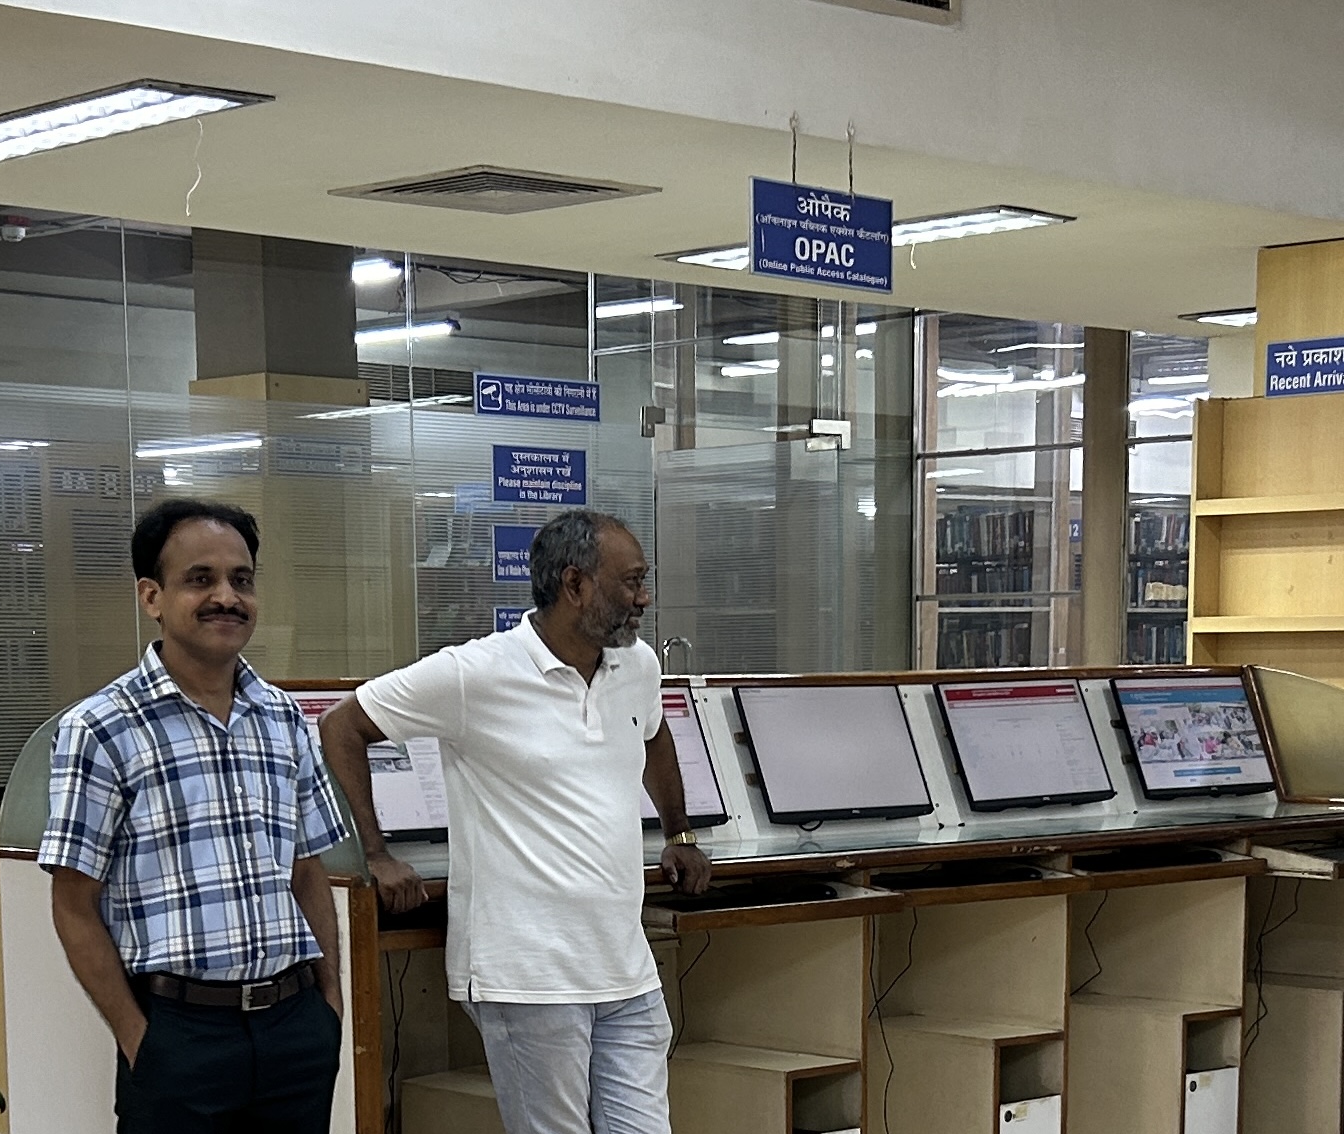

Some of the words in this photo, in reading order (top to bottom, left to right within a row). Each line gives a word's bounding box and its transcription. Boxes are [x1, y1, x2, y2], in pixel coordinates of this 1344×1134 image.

[797, 192, 851, 222] ओपैक
[795, 236, 854, 267] OPAC
[759, 258, 787, 271] (Online
[790, 262, 814, 275] Public
[817, 267, 844, 279] Access
[846, 270, 887, 287] Catalogue)
[1274, 345, 1297, 368] नये
[1270, 371, 1311, 391] Recent
[505, 399, 516, 410] This
[517, 400, 530, 412] Area
[536, 402, 551, 413] under
[551, 403, 565, 415] CCTV
[565, 404, 597, 416] Surveillance
[512, 452, 559, 464] पुस्तकालय
[561, 452, 570, 464] में
[510, 464, 553, 478] अनुशासन
[498, 476, 521, 488] Please
[552, 480, 582, 492] discipline
[539, 489, 563, 502] Library
